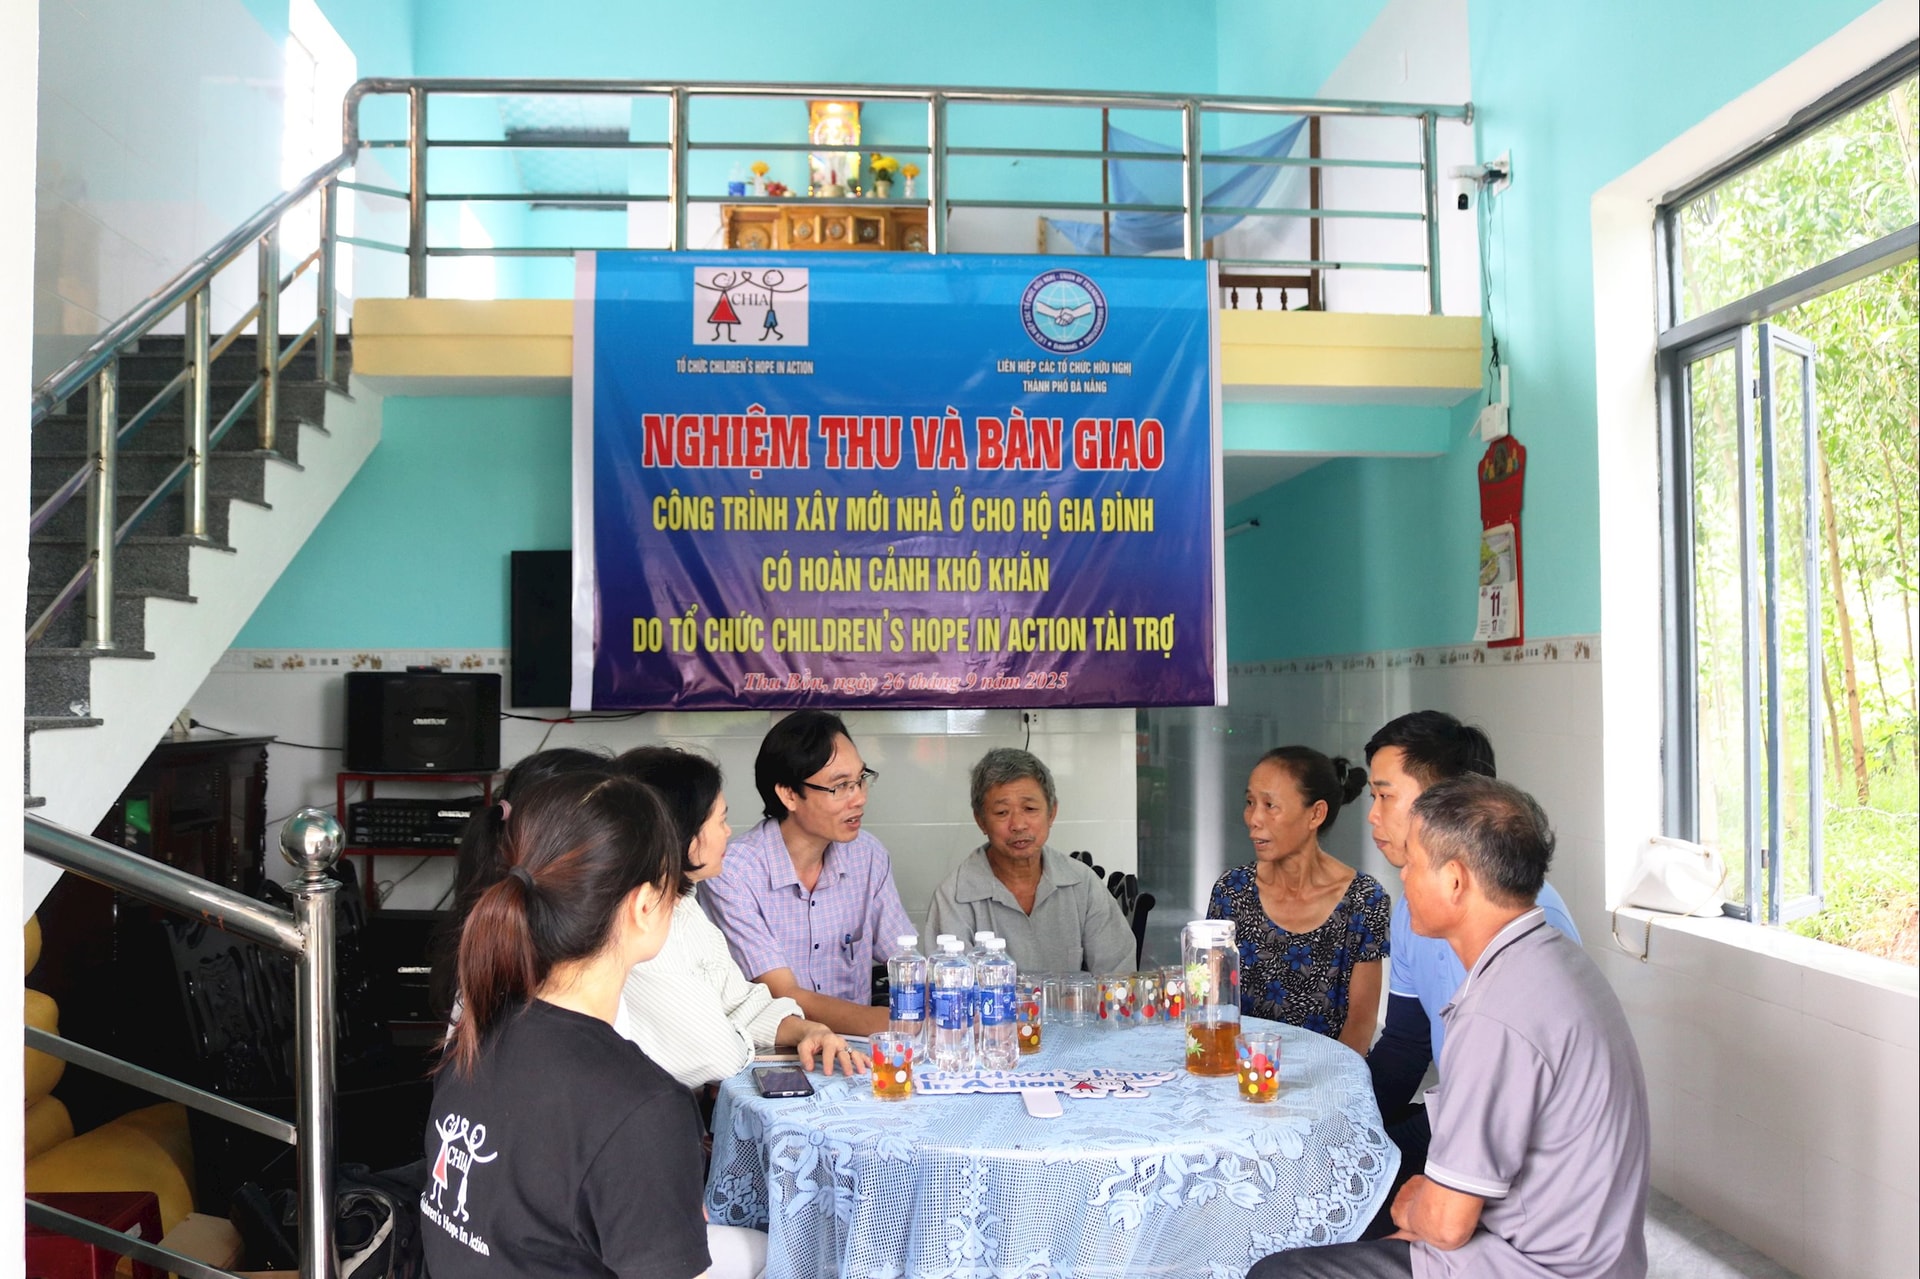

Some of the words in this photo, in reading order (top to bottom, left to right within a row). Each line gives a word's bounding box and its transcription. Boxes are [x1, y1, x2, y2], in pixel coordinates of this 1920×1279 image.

[731, 292, 769, 306] CHIA
[709, 357, 753, 374] CHILDREN'S
[755, 360, 775, 374] HOPE
[776, 360, 785, 374] IN
[786, 361, 814, 374] ACTION
[997, 358, 1016, 373] LIÊN
[1017, 359, 1037, 375] HIỆP
[1039, 358, 1055, 373] CÁC
[1069, 359, 1092, 374] CHỨC
[1112, 361, 1132, 377] NGHỊ
[1022, 378, 1050, 392] THÀNH
[1052, 377, 1068, 392] PHỐ
[1070, 379, 1082, 392] ĐÀ
[642, 402, 810, 479] NGHIỆM
[819, 415, 902, 469] THU
[911, 405, 967, 470] VÀ
[976, 406, 1063, 471] BÀN
[1072, 418, 1165, 471] GIAO
[652, 488, 715, 531] CÔNG
[721, 489, 788, 531] TRÌNH
[795, 489, 839, 532] XÂY
[846, 489, 890, 532] MỚI
[896, 490, 943, 532] NHÀ
[950, 486, 965, 532] Ở
[971, 497, 1015, 532] CHO
[1022, 490, 1051, 540] HỘ
[1058, 497, 1096, 532] GIA
[1101, 491, 1154, 532] ĐÌNH
[762, 550, 793, 592] CÓ
[799, 550, 861, 592] HOÀN
[868, 546, 930, 592] CẢNH
[937, 551, 981, 592] KHÓ
[988, 551, 1049, 592] KHĂN
[1490, 591, 1500, 616] 11
[633, 617, 663, 653] DO
[669, 603, 698, 653] TỔ
[703, 610, 765, 653] CHỨC
[772, 609, 904, 653] CHILDREN'S
[911, 617, 969, 653] HOPE
[977, 617, 1000, 653] IN
[1008, 617, 1087, 653] ACTION
[1093, 609, 1127, 652] TÀI
[1133, 613, 1175, 659] TRỢ
[744, 672, 781, 690] Thu
[784, 667, 829, 691] Bồn,
[833, 672, 878, 695] ngày
[881, 672, 905, 690] 26
[907, 671, 961, 694] tháng
[965, 672, 977, 689] 9
[980, 671, 1020, 689] năm
[1025, 671, 1068, 689] 2025
[922, 1081, 951, 1090] In
[962, 1080, 1064, 1088] Action
[448, 1146, 468, 1173] CHIA
[443, 1214, 458, 1239] Hope
[459, 1226, 468, 1245] In
[468, 1232, 490, 1256] Action
